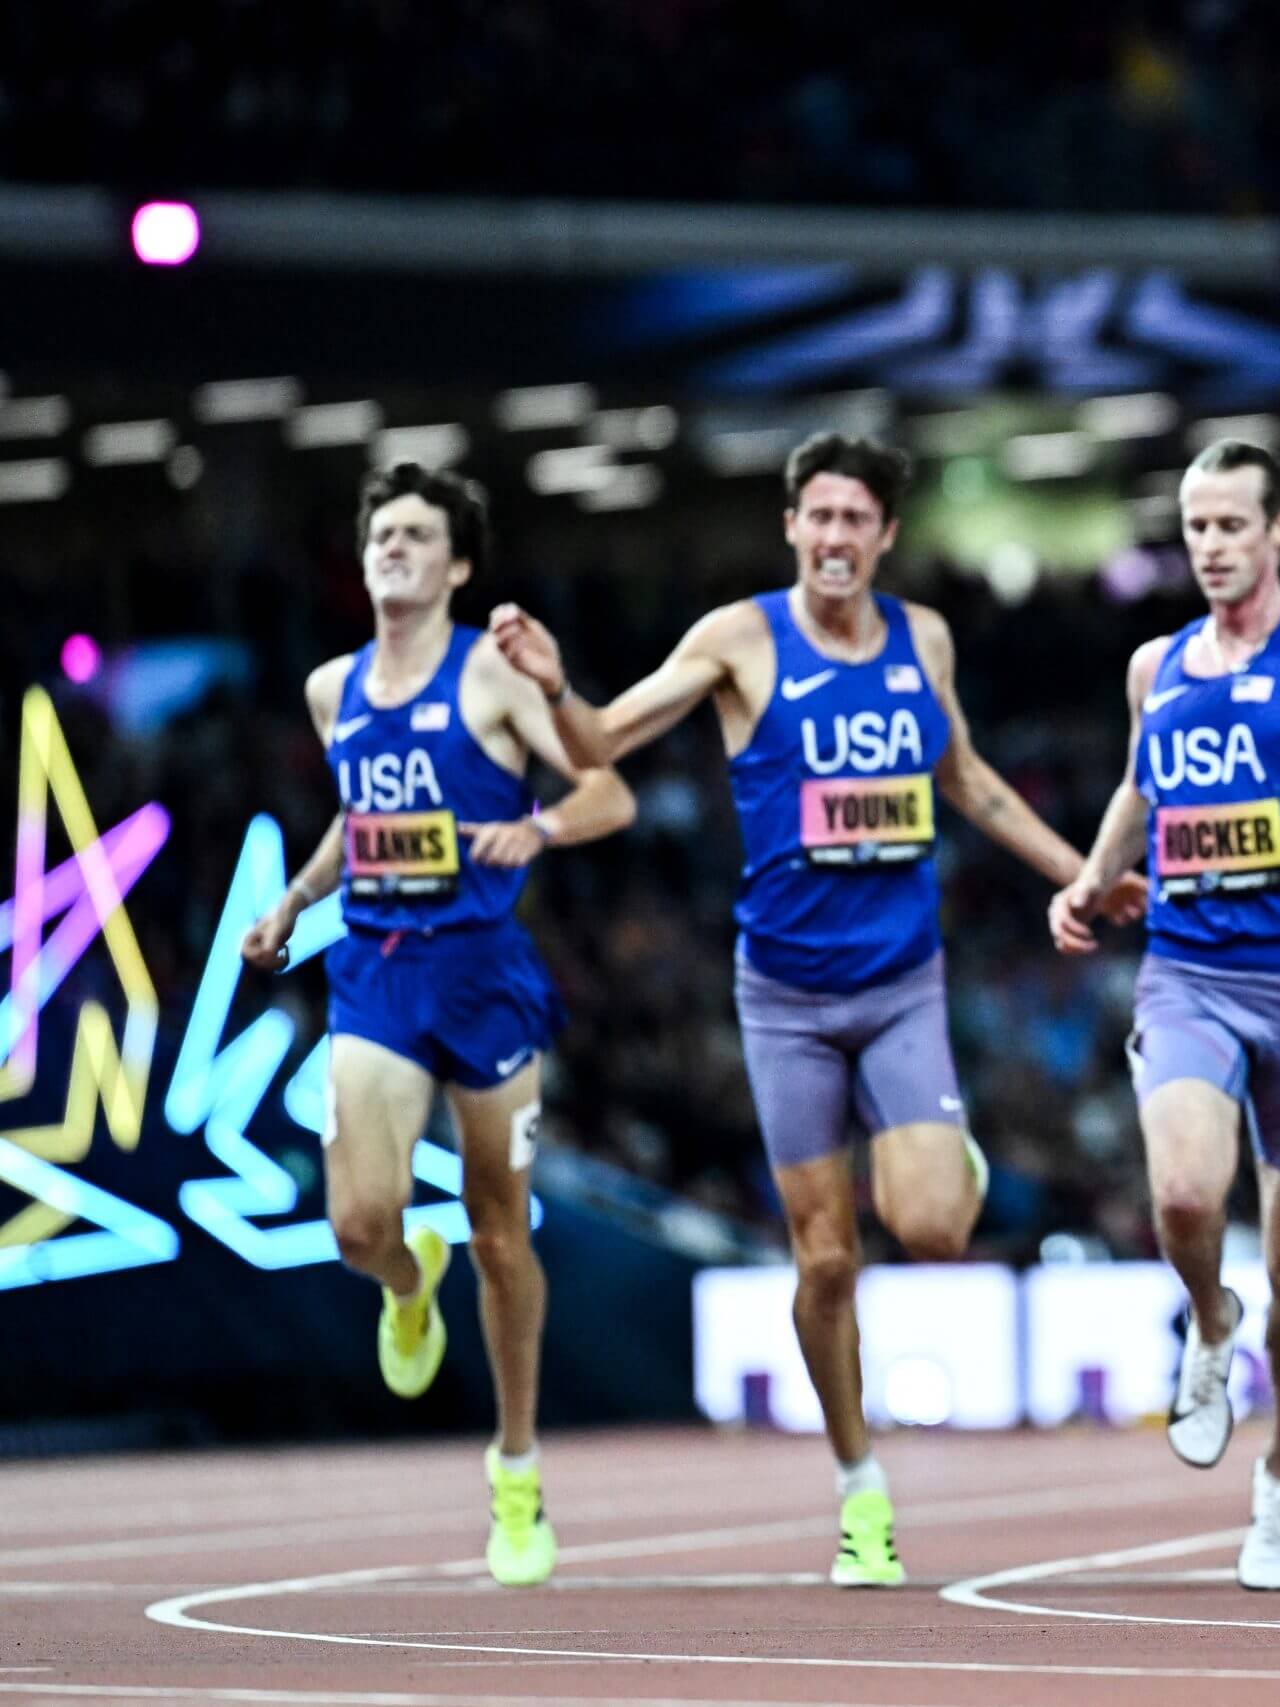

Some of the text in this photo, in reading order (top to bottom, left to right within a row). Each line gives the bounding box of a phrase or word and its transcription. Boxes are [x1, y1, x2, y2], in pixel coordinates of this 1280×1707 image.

[801, 708, 923, 775] USA
[1148, 723, 1268, 790] USA
[338, 747, 443, 813] USA
[821, 791, 920, 832] YOUNG
